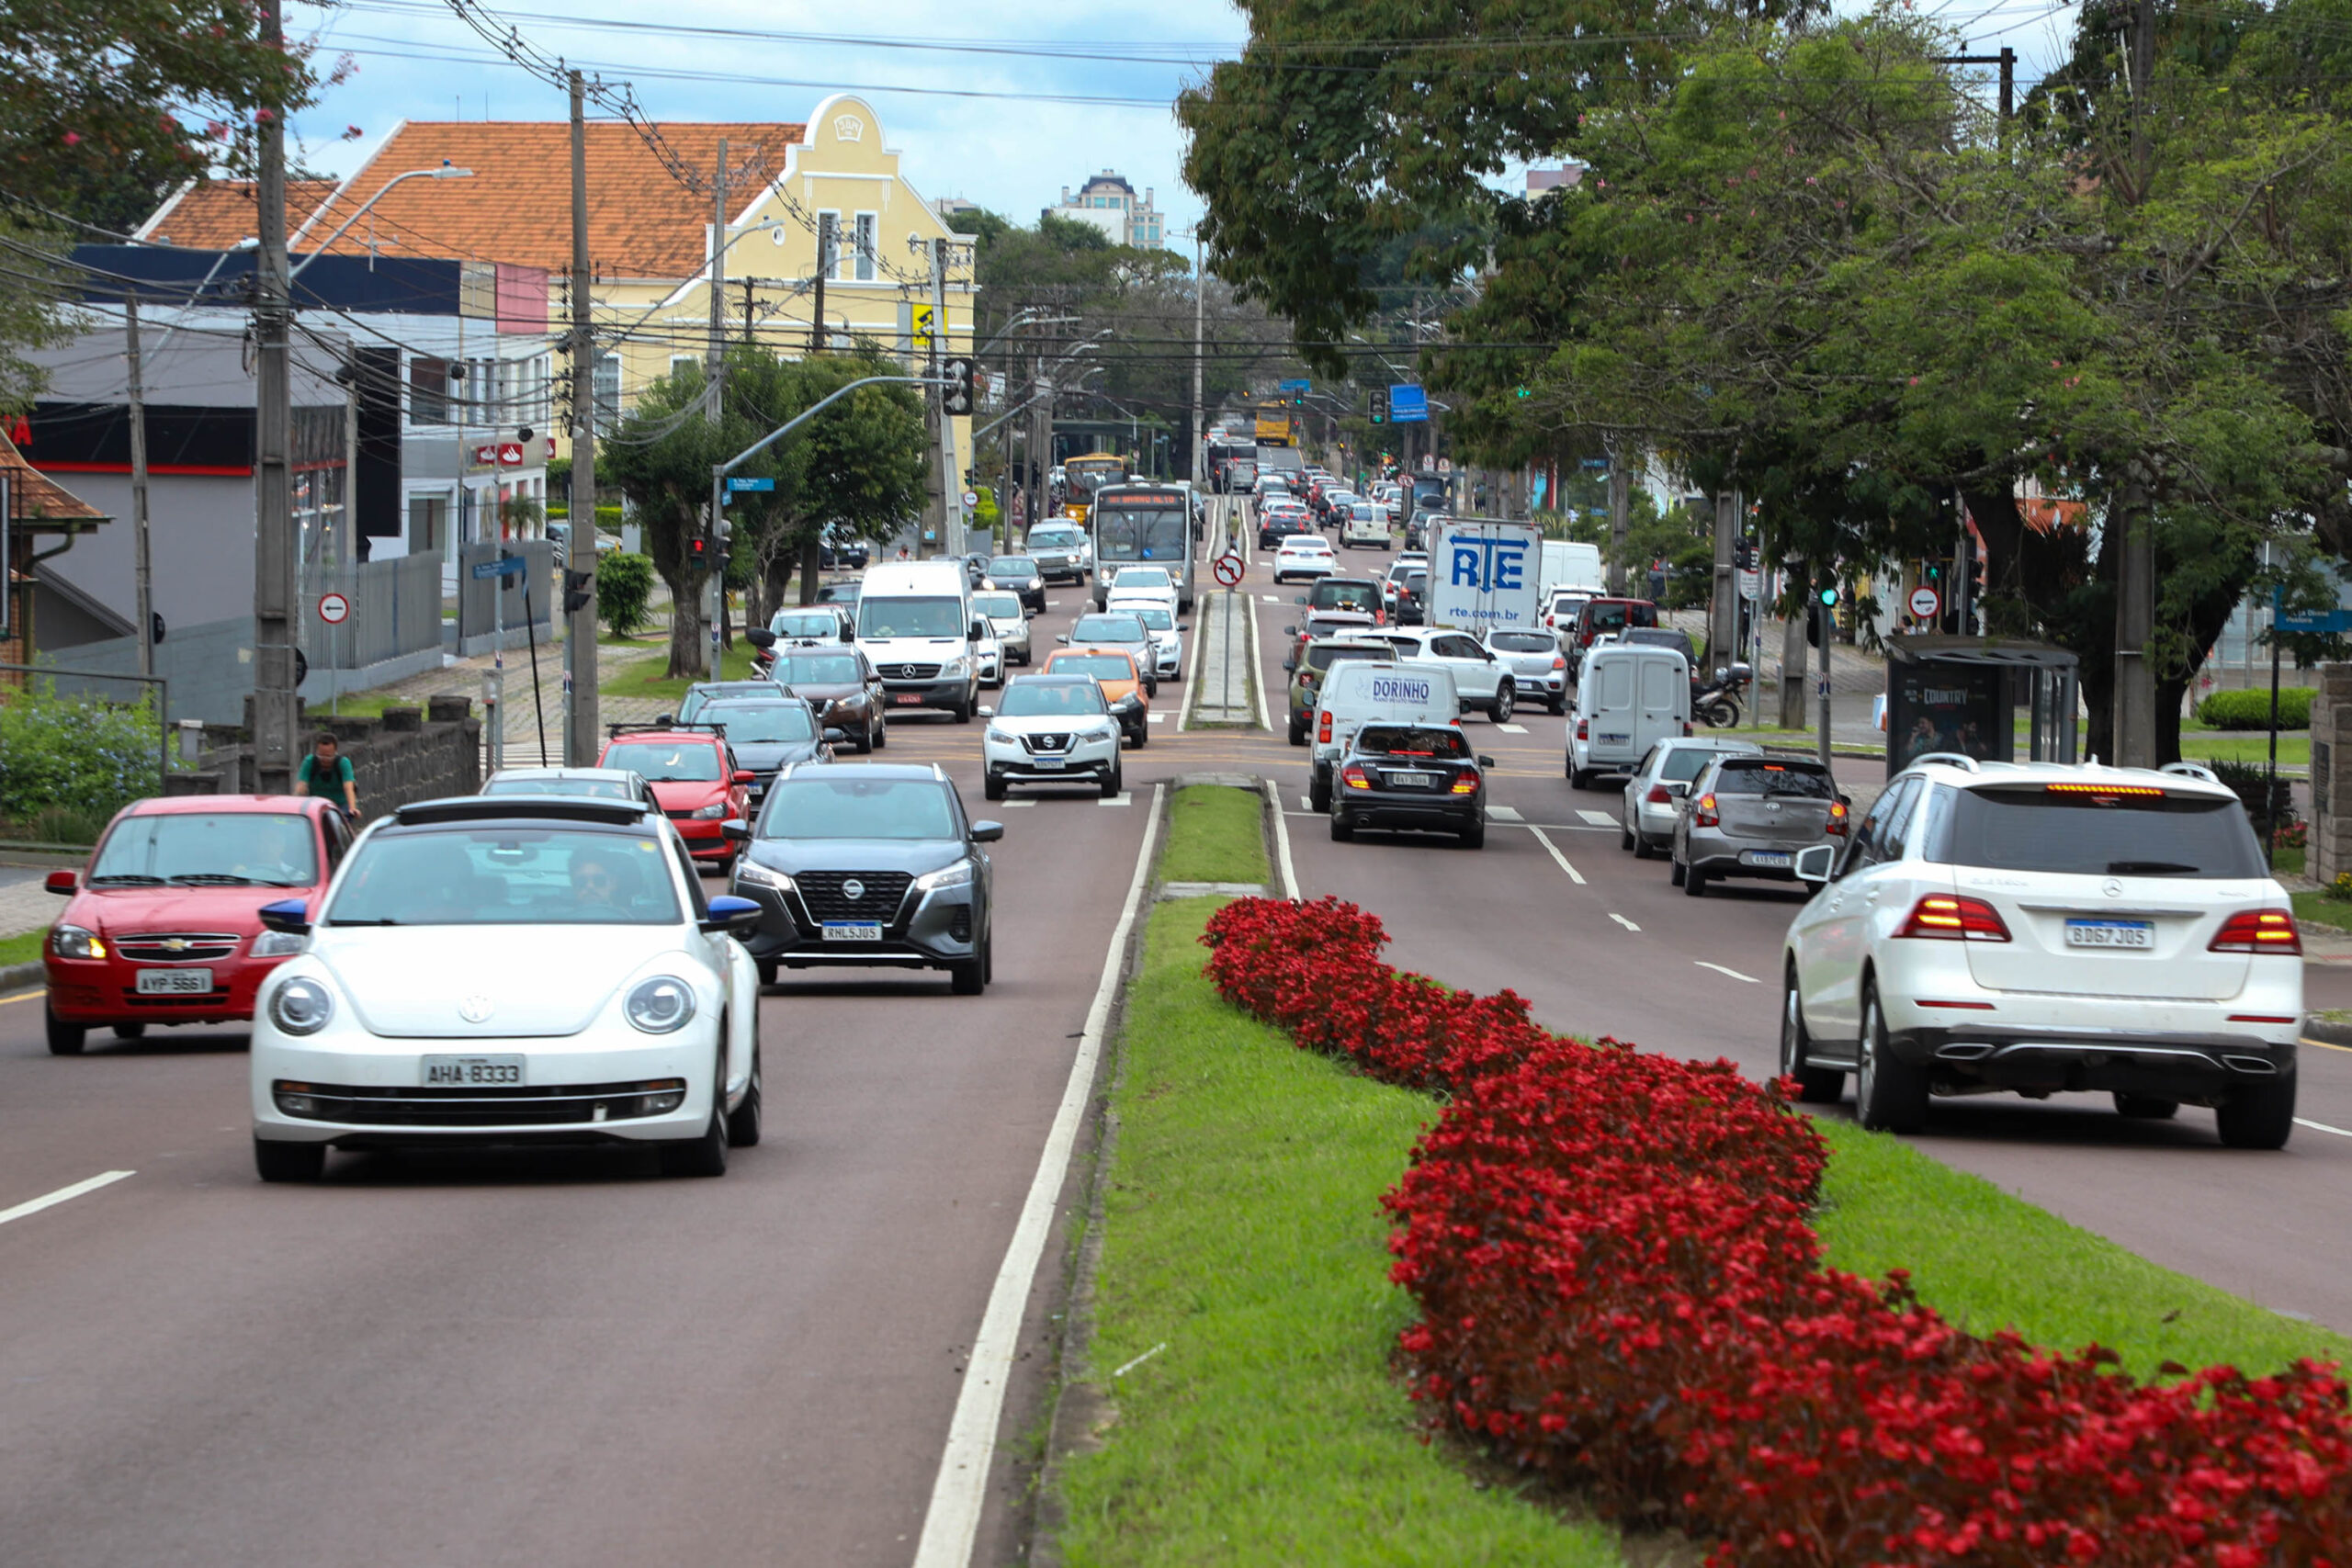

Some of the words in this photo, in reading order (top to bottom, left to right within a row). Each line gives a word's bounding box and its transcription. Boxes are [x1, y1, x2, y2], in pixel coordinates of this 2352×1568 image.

[1153, 495, 1174, 504] ALTO
[1449, 535, 1530, 594] RTE
[1450, 607, 1520, 621] rte.com.br
[1374, 680, 1430, 699] DORINHO
[1924, 688, 1968, 705] COUNTRY
[428, 1066, 520, 1082] AHA-8333
